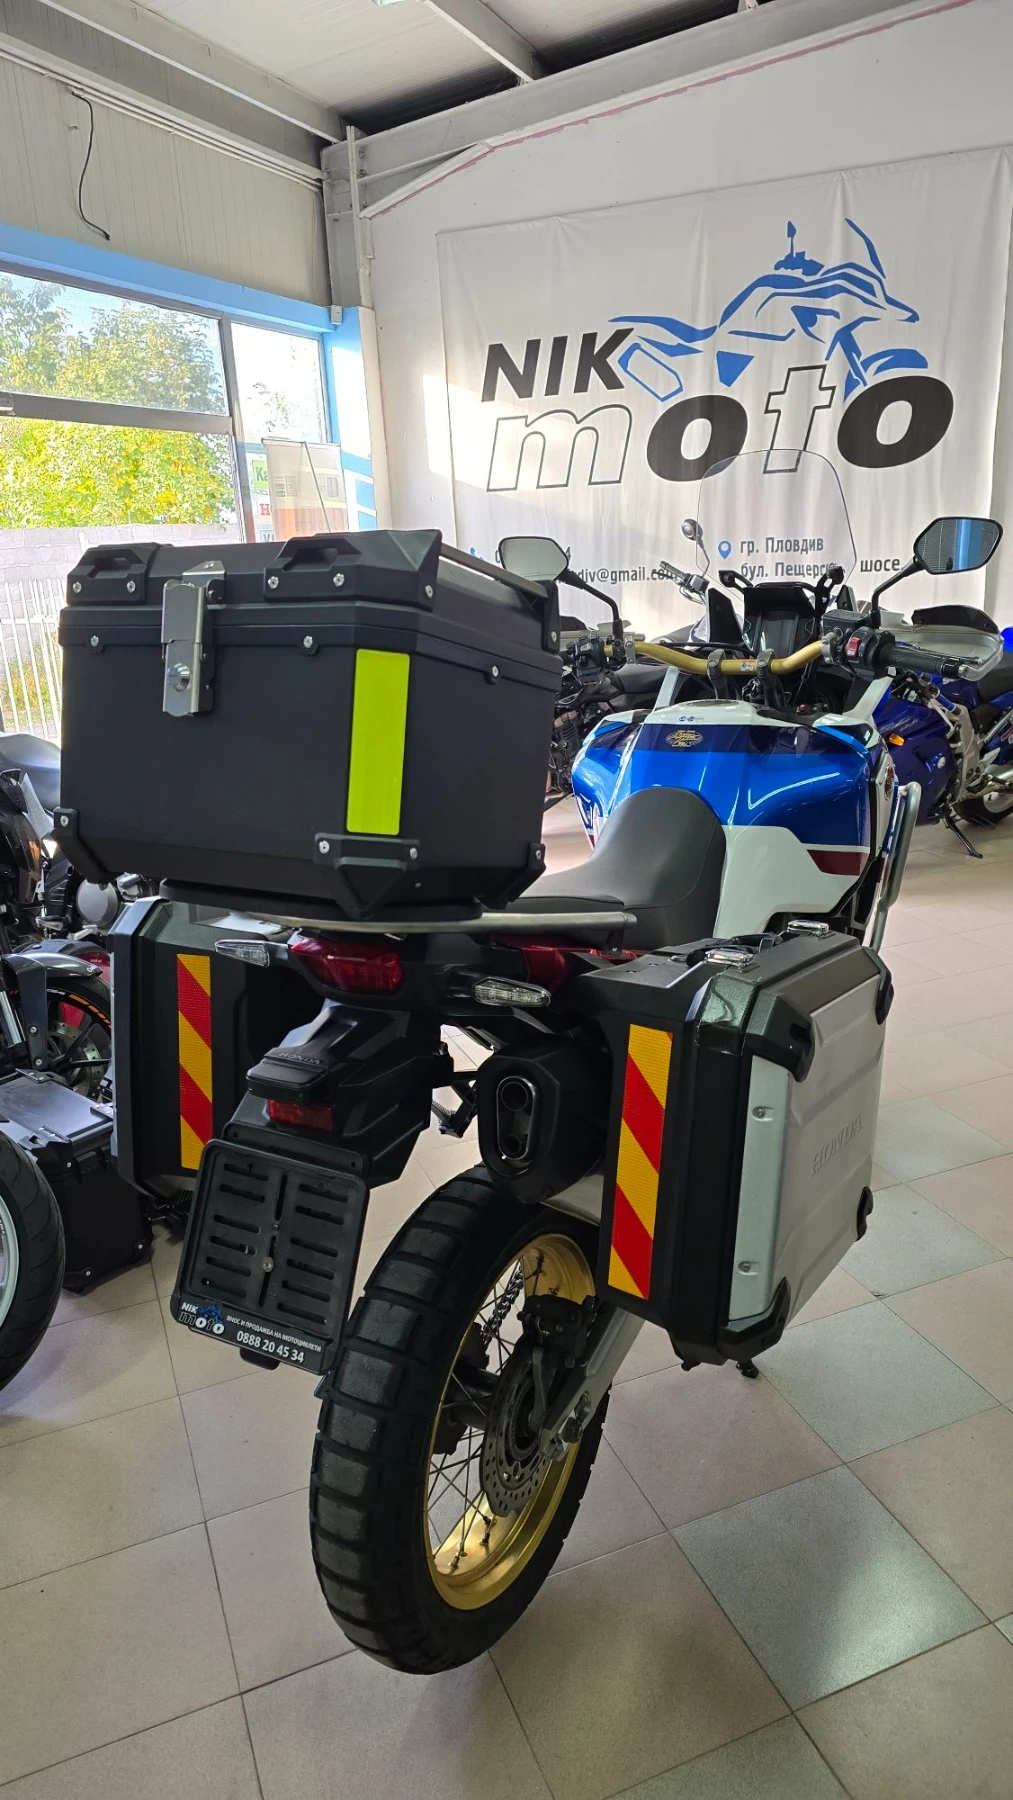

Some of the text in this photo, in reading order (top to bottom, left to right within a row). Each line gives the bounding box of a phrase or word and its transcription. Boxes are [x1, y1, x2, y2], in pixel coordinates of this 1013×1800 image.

[481, 328, 635, 402] NIK
[486, 364, 954, 492] moto
[740, 537, 824, 556] гр. Пловдив
[740, 562, 769, 581] бул.
[860, 558, 901, 573] шосе
[811, 1113, 863, 1177] HONDA
[178, 1312, 225, 1335] moto
[181, 1301, 199, 1315] NIK
[236, 1330, 305, 1363] 0888 20 45 34
[245, 1321, 274, 1336] ПРОДАЖБА
[274, 1331, 282, 1339] НА
[281, 1333, 322, 1353] МОТОЦИКЛЕТИ
